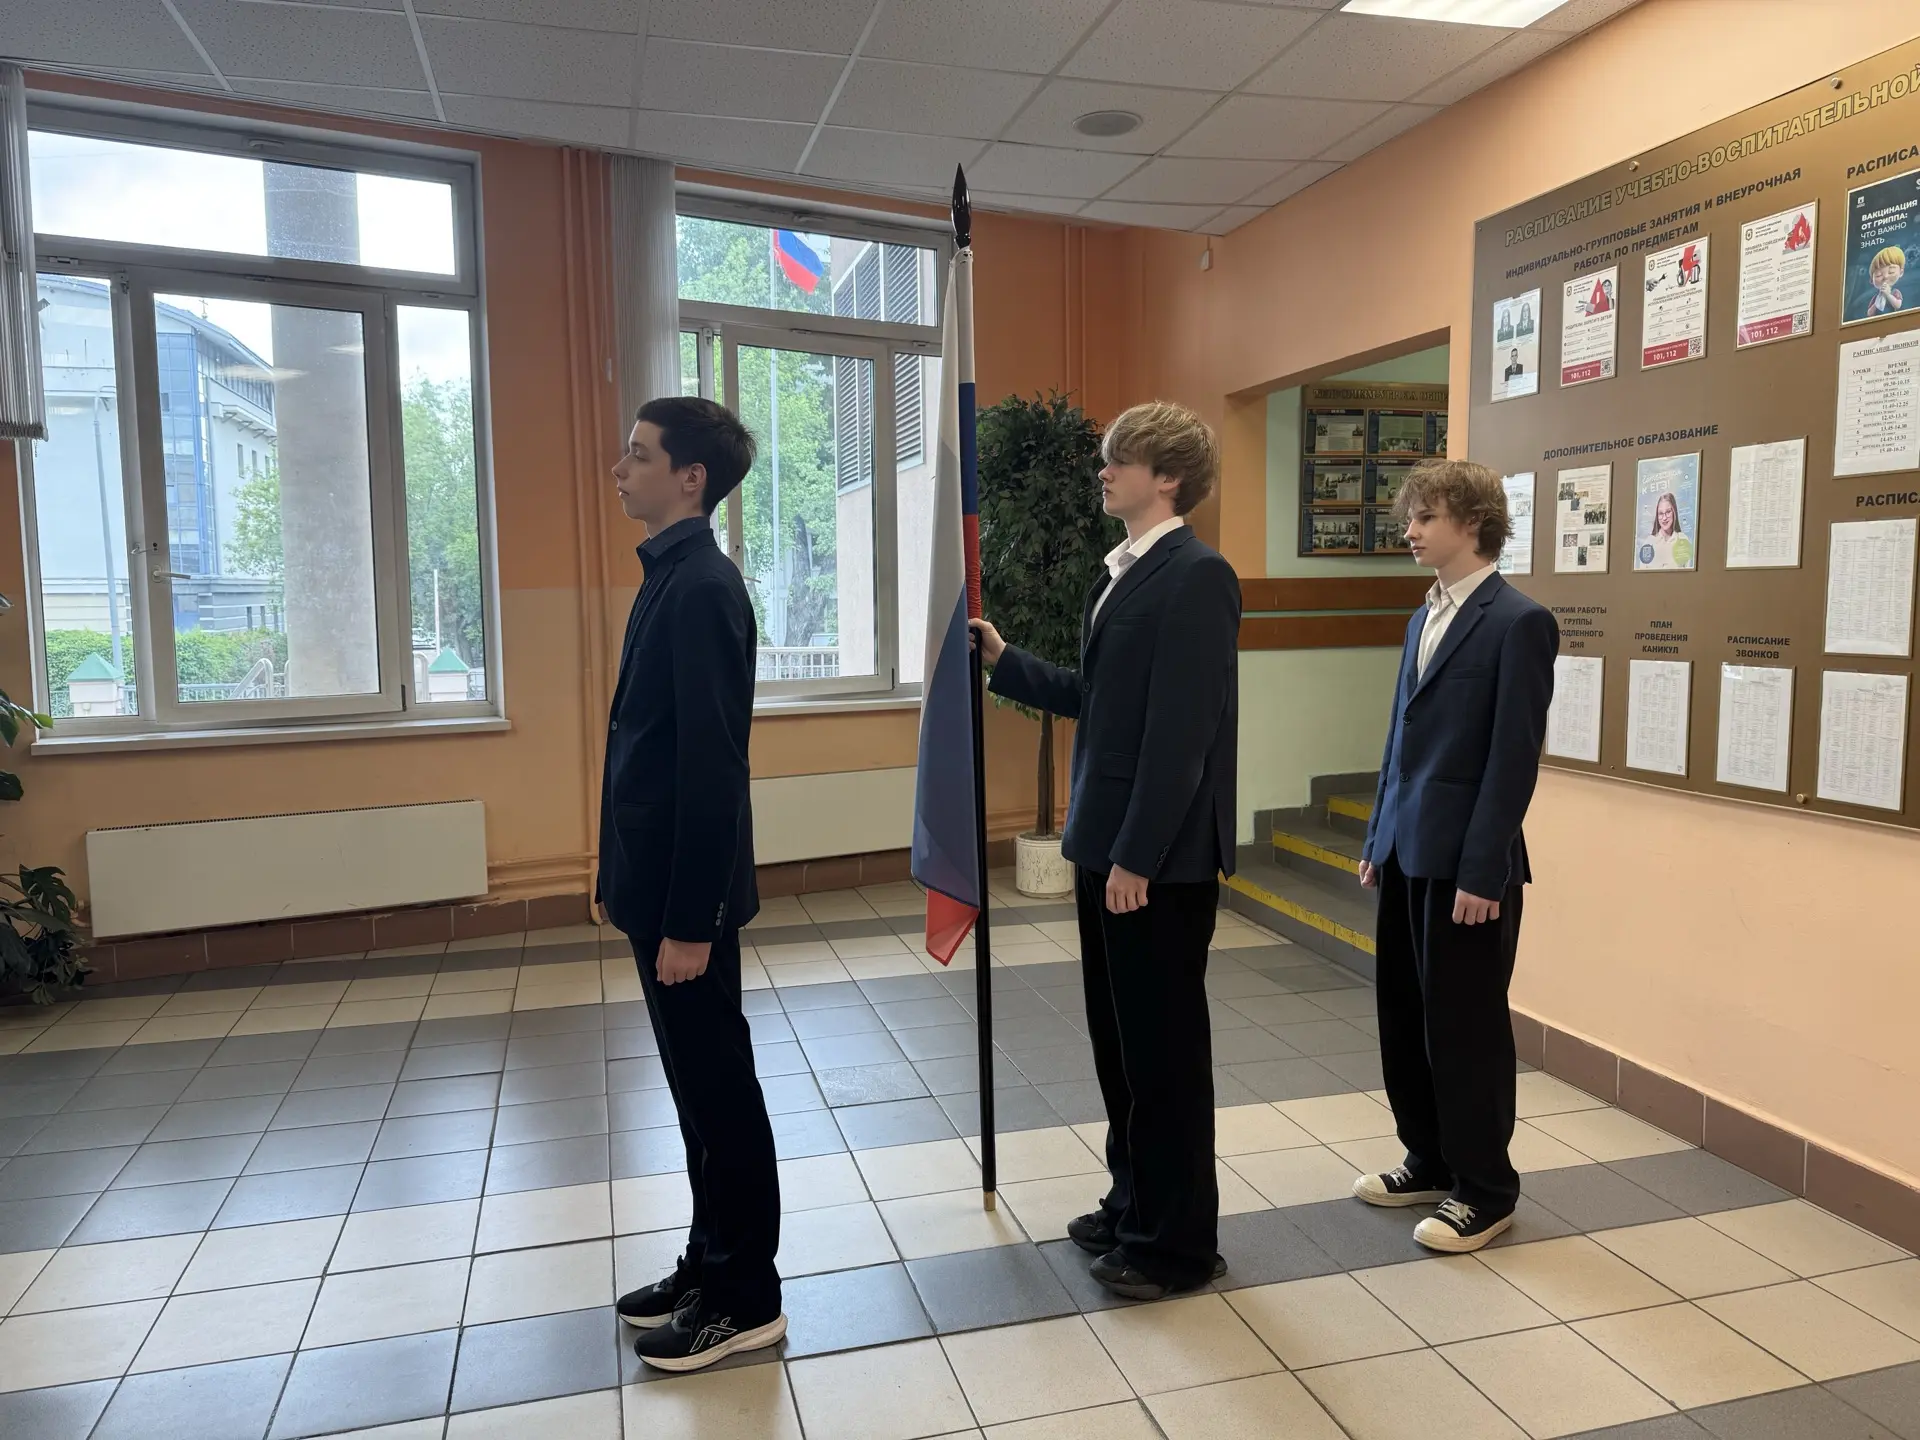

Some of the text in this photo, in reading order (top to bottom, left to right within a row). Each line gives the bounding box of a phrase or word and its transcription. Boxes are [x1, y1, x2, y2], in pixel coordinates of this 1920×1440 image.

[1861, 200, 1918, 222] ВАКЦИНАЦИЯ
[1505, 191, 1612, 247] РАСПИСАНИЕ
[1505, 222, 1647, 279] ИНДИВИДУАЛЬНО-ГРУППОВЫЕ
[1649, 204, 1700, 230] ЗАНЯТИЯ
[1704, 198, 1713, 210] И
[1716, 168, 1801, 206] ВНЕУРОЧНАЯ
[1861, 213, 1908, 231] ОТ ГРИППА:
[1860, 221, 1907, 240] ЧТО ВАЖНО
[1573, 222, 1699, 272] РАБОТА ПО ПРЕДМЕТАМ
[1860, 237, 1885, 249] ЗНАТЬ
[1766, 326, 1779, 335] 112
[1666, 350, 1677, 358] 112
[1543, 424, 1719, 461] ДОПОЛНИТЕЛЬНОЕ ОБРАЗОВАНИЕ
[1855, 491, 1920, 508] РАСПИС
[1551, 606, 1607, 614] РЕЖИМ РАБОТЫ
[1563, 618, 1593, 626] ГРУППЫ
[1650, 620, 1673, 629] ПЛАН
[1634, 632, 1688, 642] ПРОВЕДЕНИЯ
[1727, 635, 1791, 646] РАСПИСАНИЕ
[1569, 641, 1585, 649] ДНЯ
[1642, 645, 1679, 654] КАНИКУЛ
[1735, 649, 1780, 659] ЗВОНКОВ
